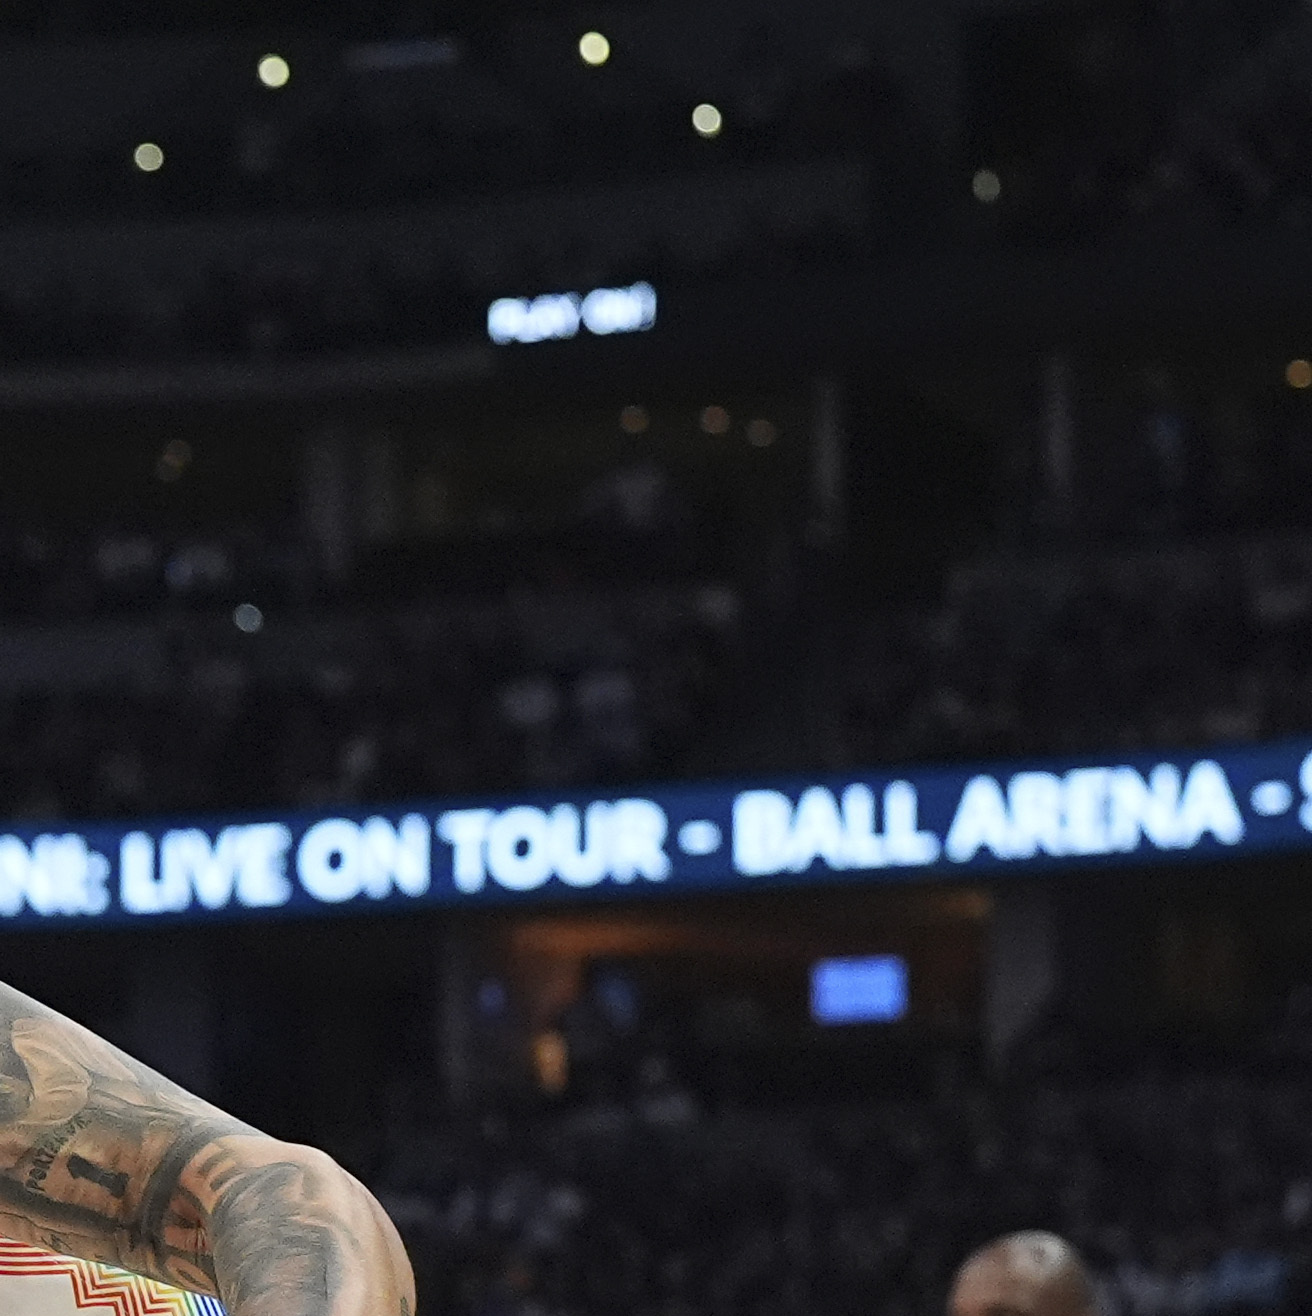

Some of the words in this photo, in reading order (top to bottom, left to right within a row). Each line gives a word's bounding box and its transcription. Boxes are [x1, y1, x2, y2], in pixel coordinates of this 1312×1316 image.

[119, 823, 292, 914] LIVE
[297, 814, 431, 902] ON
[437, 799, 670, 893] TOUR
[732, 781, 940, 876] BALL
[945, 761, 1243, 862] ARENA
